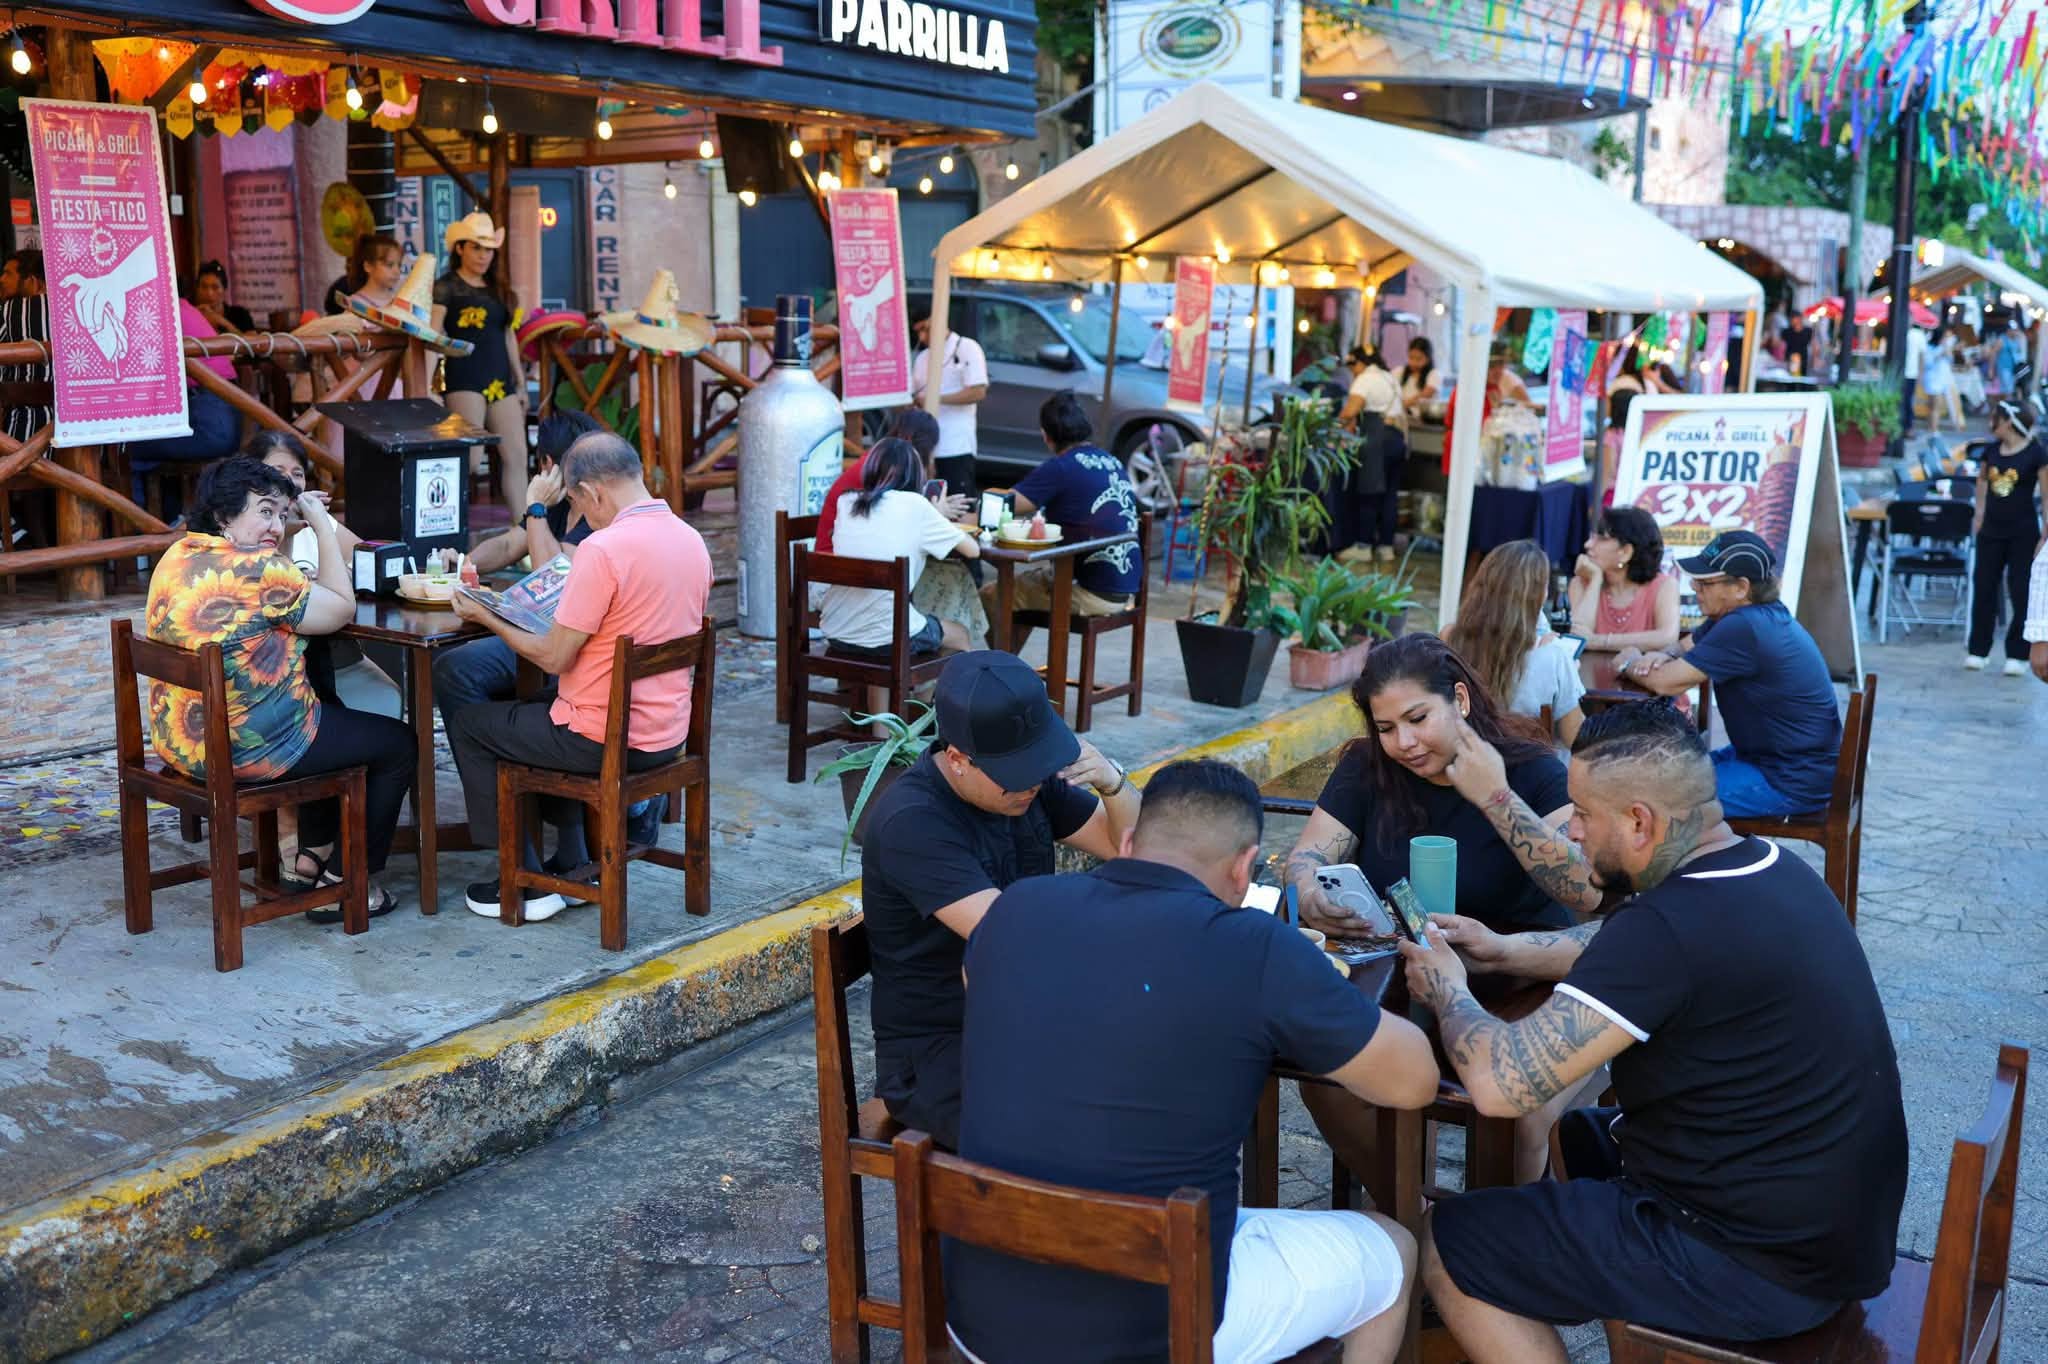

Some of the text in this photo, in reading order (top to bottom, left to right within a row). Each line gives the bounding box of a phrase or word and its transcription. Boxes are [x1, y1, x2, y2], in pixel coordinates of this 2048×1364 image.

[831, 0, 1010, 74] PARRILLA
[45, 126, 144, 156] PICAÑA & GRILL
[593, 167, 617, 222] CAR
[51, 198, 103, 222] FIESTA
[109, 200, 147, 223] TACO
[1731, 430, 1769, 442] GRILL
[1642, 450, 1760, 482] PASTOR
